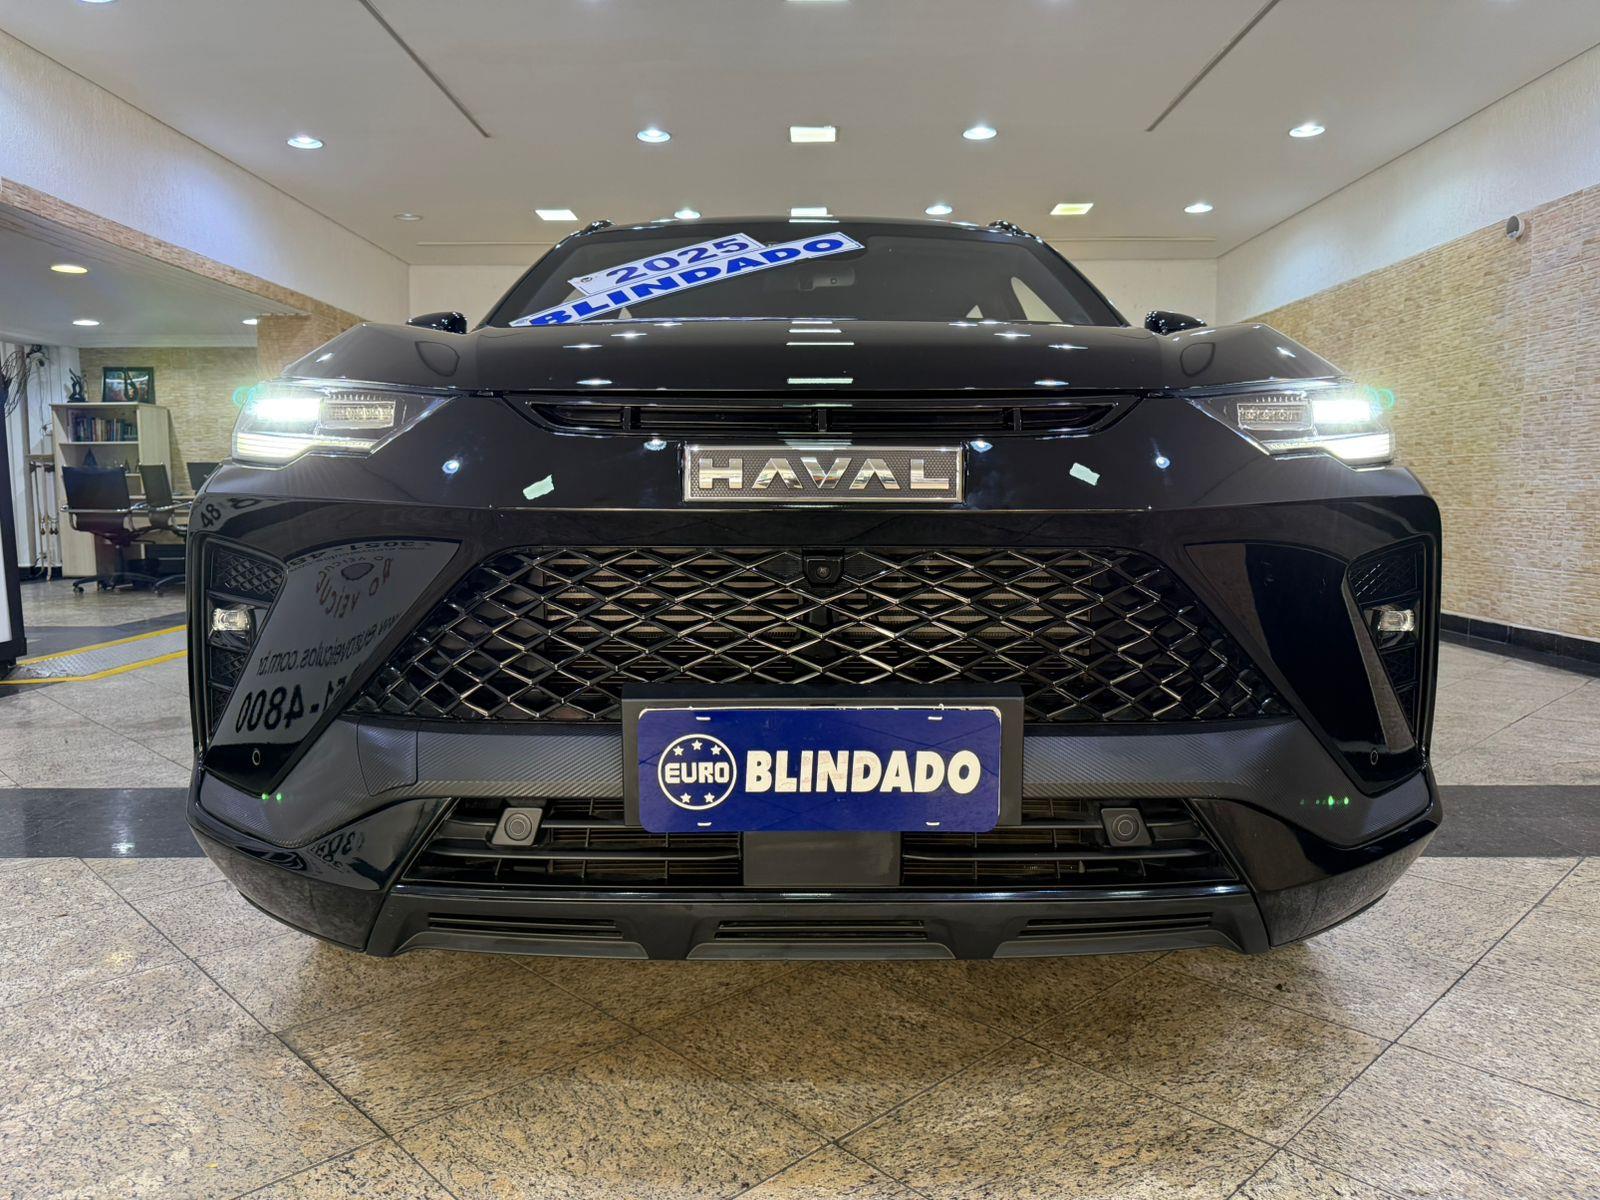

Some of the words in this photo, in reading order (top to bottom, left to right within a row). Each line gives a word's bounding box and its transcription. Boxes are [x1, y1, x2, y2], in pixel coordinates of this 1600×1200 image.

[529, 238, 845, 326] BLINDADO
[606, 238, 749, 284] 2025
[699, 457, 950, 489] HAVAL
[665, 761, 730, 783] EURO
[745, 749, 982, 795] BLINDADO
